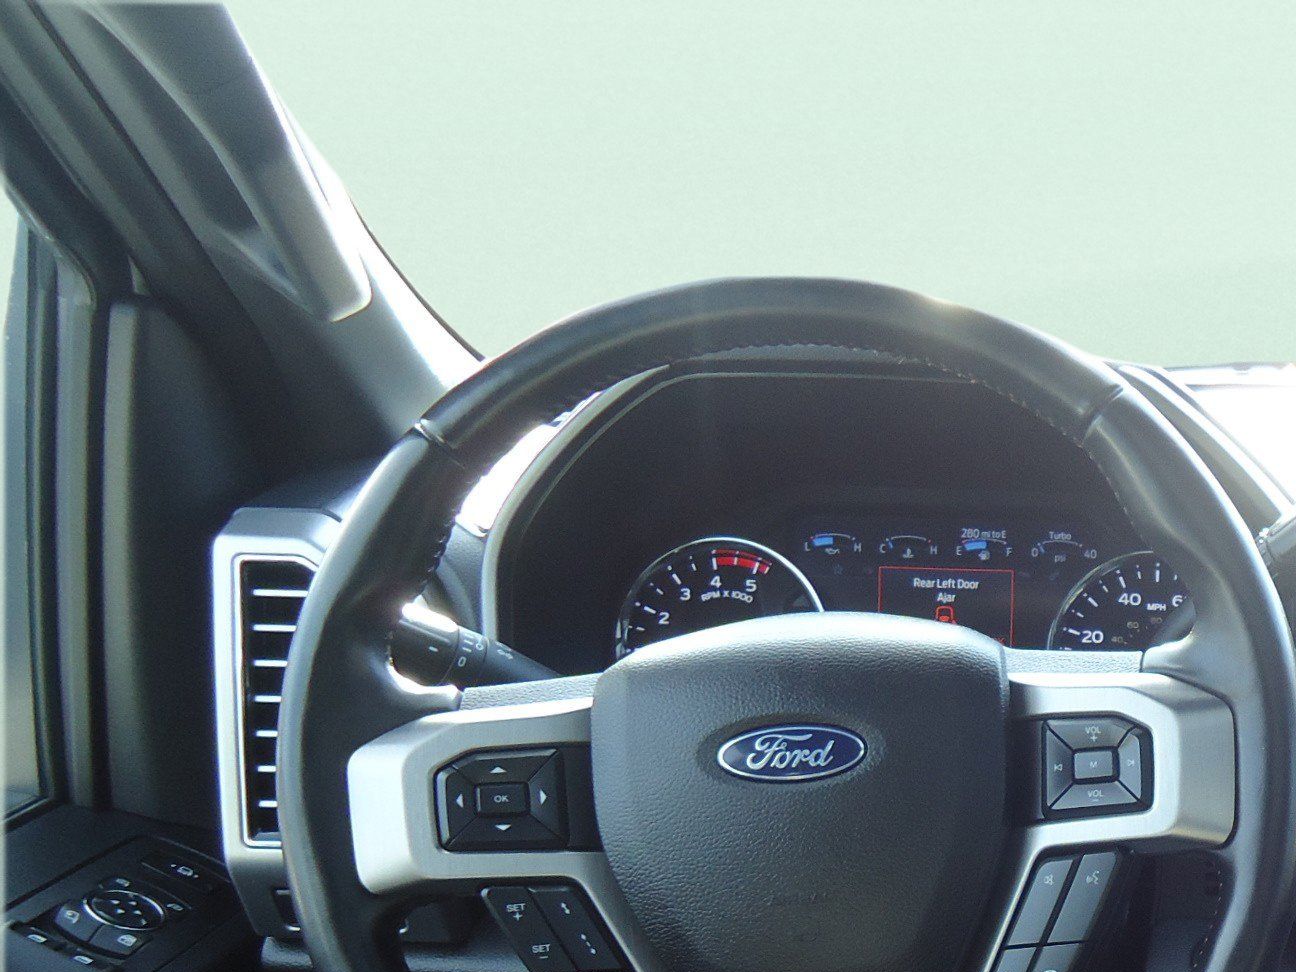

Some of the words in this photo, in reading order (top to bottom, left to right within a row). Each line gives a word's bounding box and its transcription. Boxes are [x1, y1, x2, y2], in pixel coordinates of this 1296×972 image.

[961, 528, 980, 539] 280
[992, 530, 1001, 538] to
[1001, 530, 1007, 538] E
[1049, 531, 1072, 540] Turbo
[853, 543, 861, 552] H
[879, 544, 886, 553] C
[930, 545, 937, 555] H
[956, 546, 962, 556] E
[1006, 547, 1013, 557] F
[1084, 549, 1097, 559] 40
[710, 575, 722, 588] 4
[746, 579, 757, 592] 5
[913, 578, 935, 589] Rear
[937, 578, 955, 589] Left
[957, 579, 979, 590] Door
[680, 588, 690, 601] 3
[701, 590, 720, 602] RPM
[731, 590, 753, 603] 1000
[936, 592, 956, 603] Ajar
[1118, 593, 1141, 606] 40
[1147, 603, 1166, 611] MPH
[658, 612, 670, 624] 2
[1081, 630, 1104, 644] 20
[746, 734, 833, 770] Ford
[506, 903, 526, 913] SET
[532, 943, 550, 953] SET
